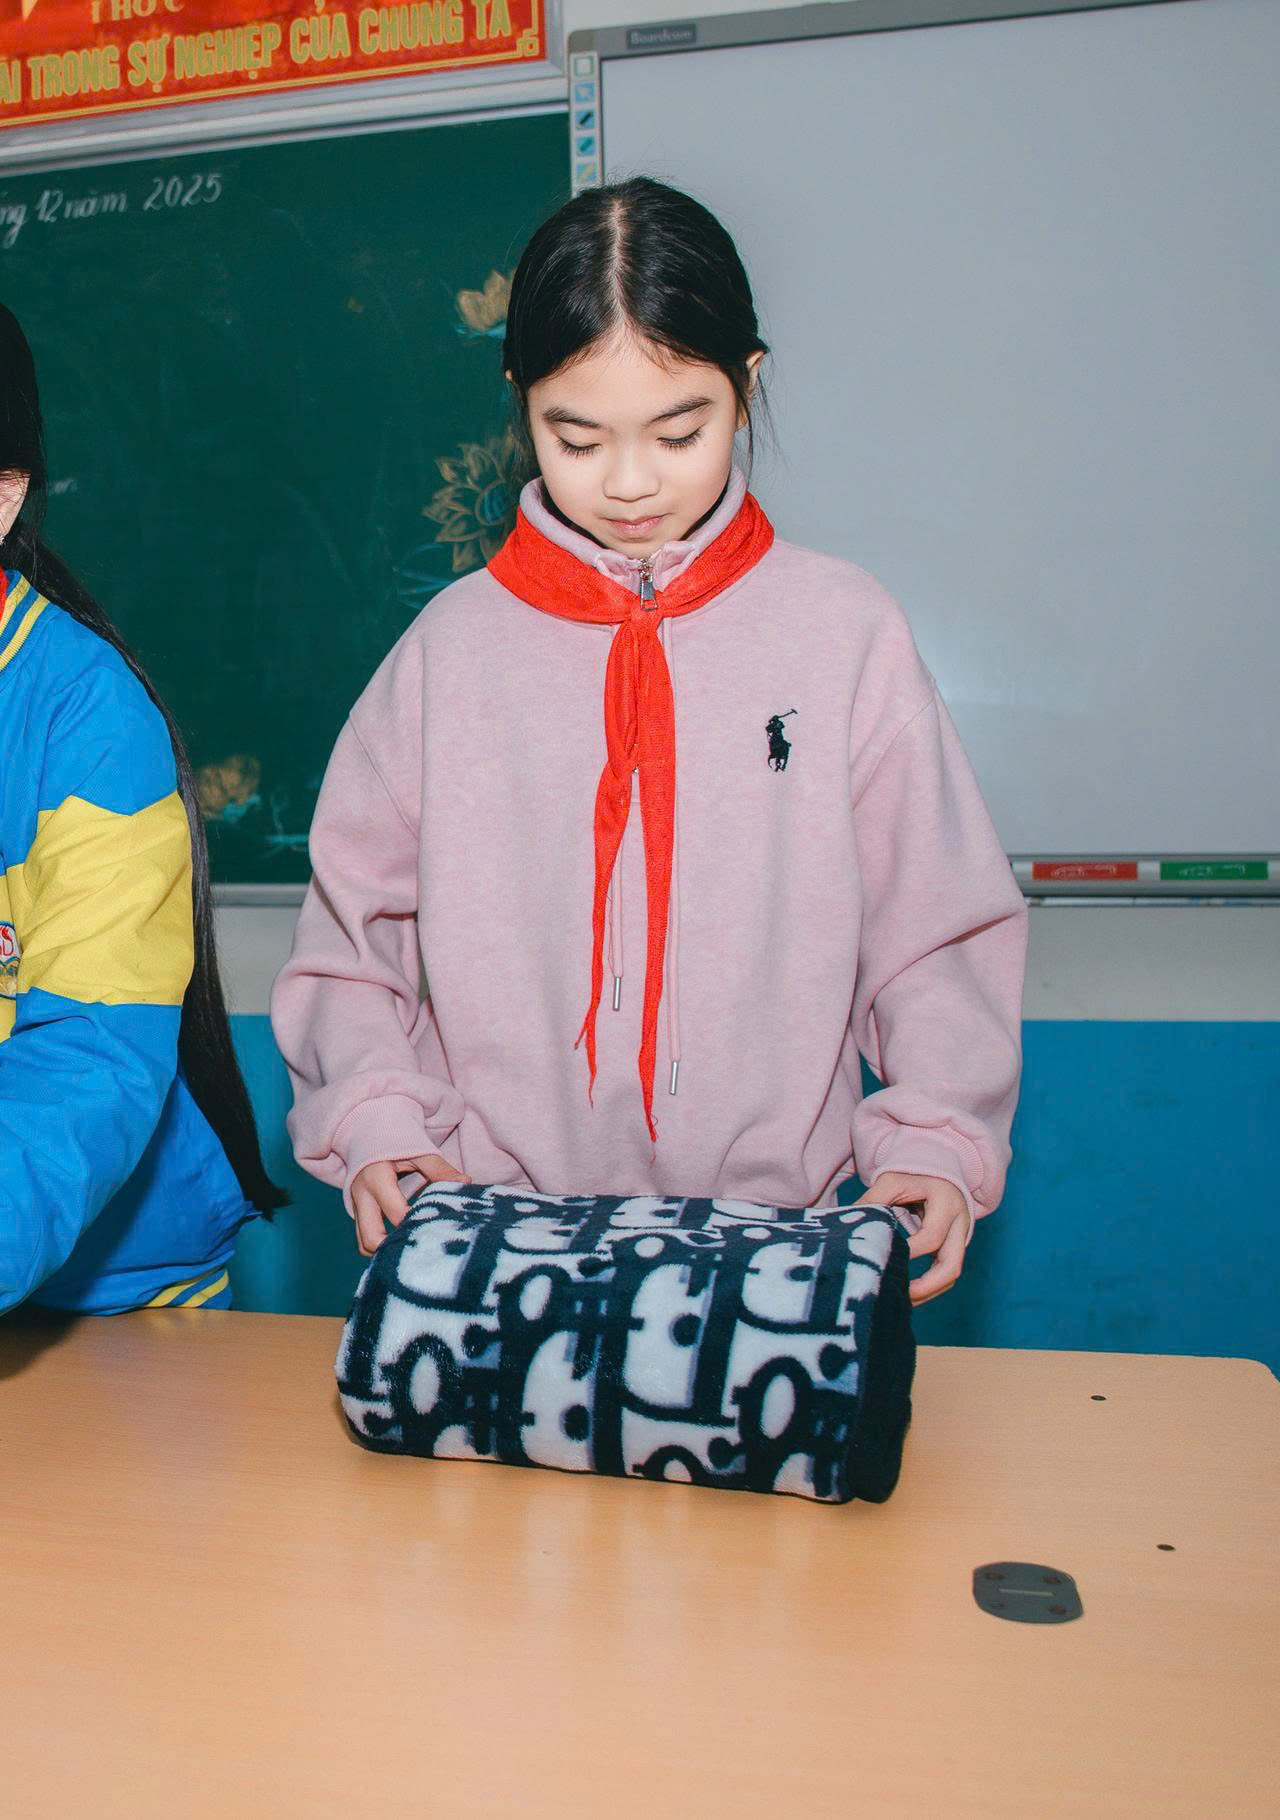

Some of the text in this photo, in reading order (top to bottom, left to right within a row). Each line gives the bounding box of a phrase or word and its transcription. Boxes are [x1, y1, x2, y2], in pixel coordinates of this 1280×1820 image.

[27, 45, 120, 100] TRONG
[127, 33, 171, 93] SỰ
[474, 0, 512, 40] TA
[36, 189, 63, 223] 12
[143, 172, 222, 211] 2025
